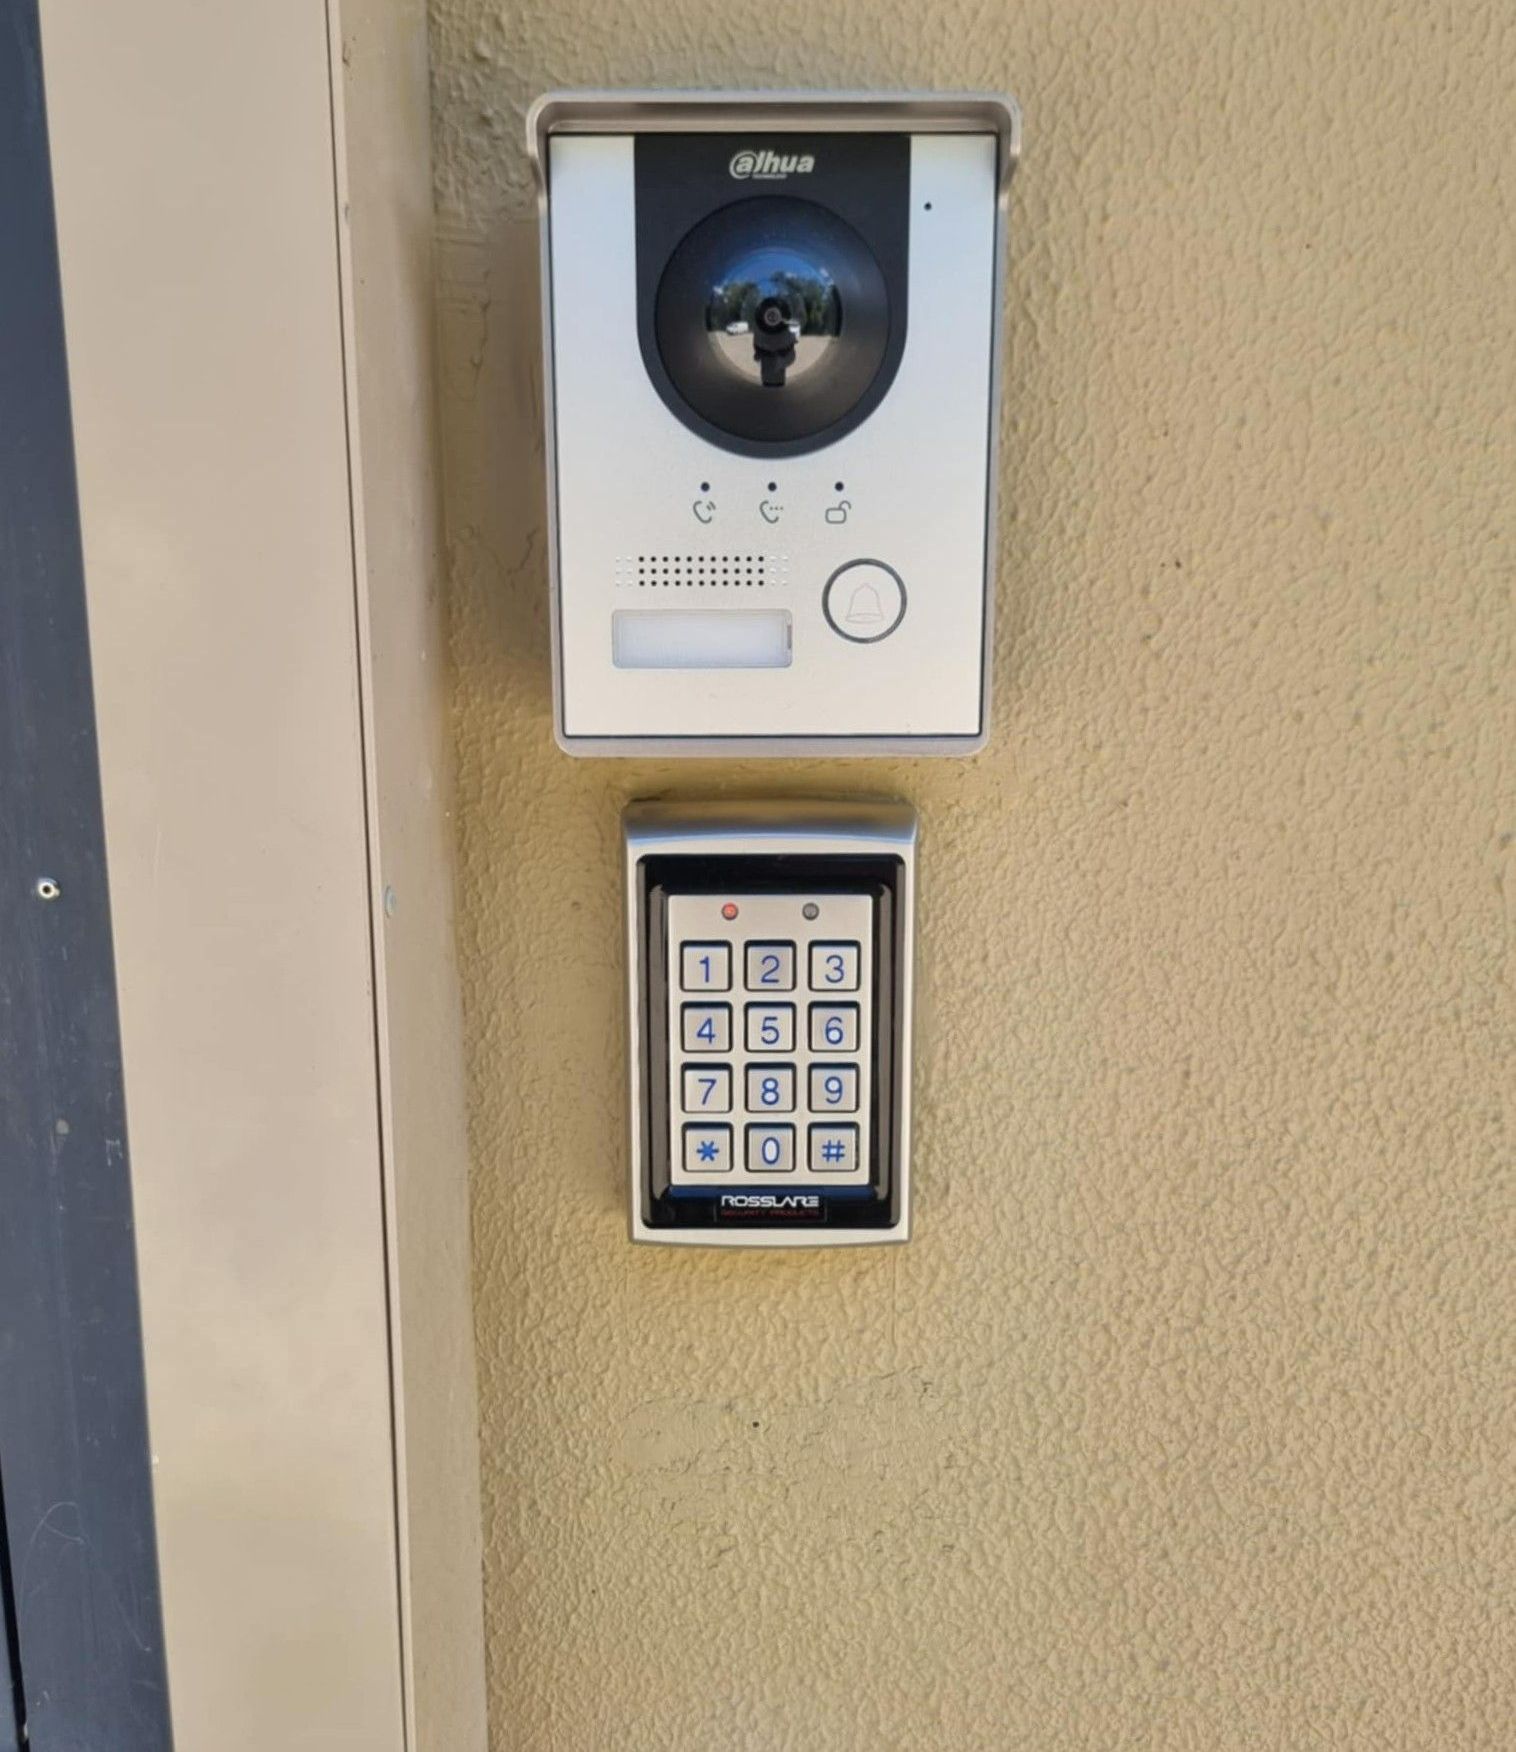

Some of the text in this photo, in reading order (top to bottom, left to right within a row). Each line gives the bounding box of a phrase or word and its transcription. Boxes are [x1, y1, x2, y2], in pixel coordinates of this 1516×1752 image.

[699, 955, 845, 983] 1 2 3
[697, 1016, 844, 1045] 4 5 6
[698, 1076, 843, 1105] 7 8 9
[761, 1137, 780, 1165] 0
[821, 1140, 845, 1162] #
[721, 1195, 819, 1208] ROSSLARE
